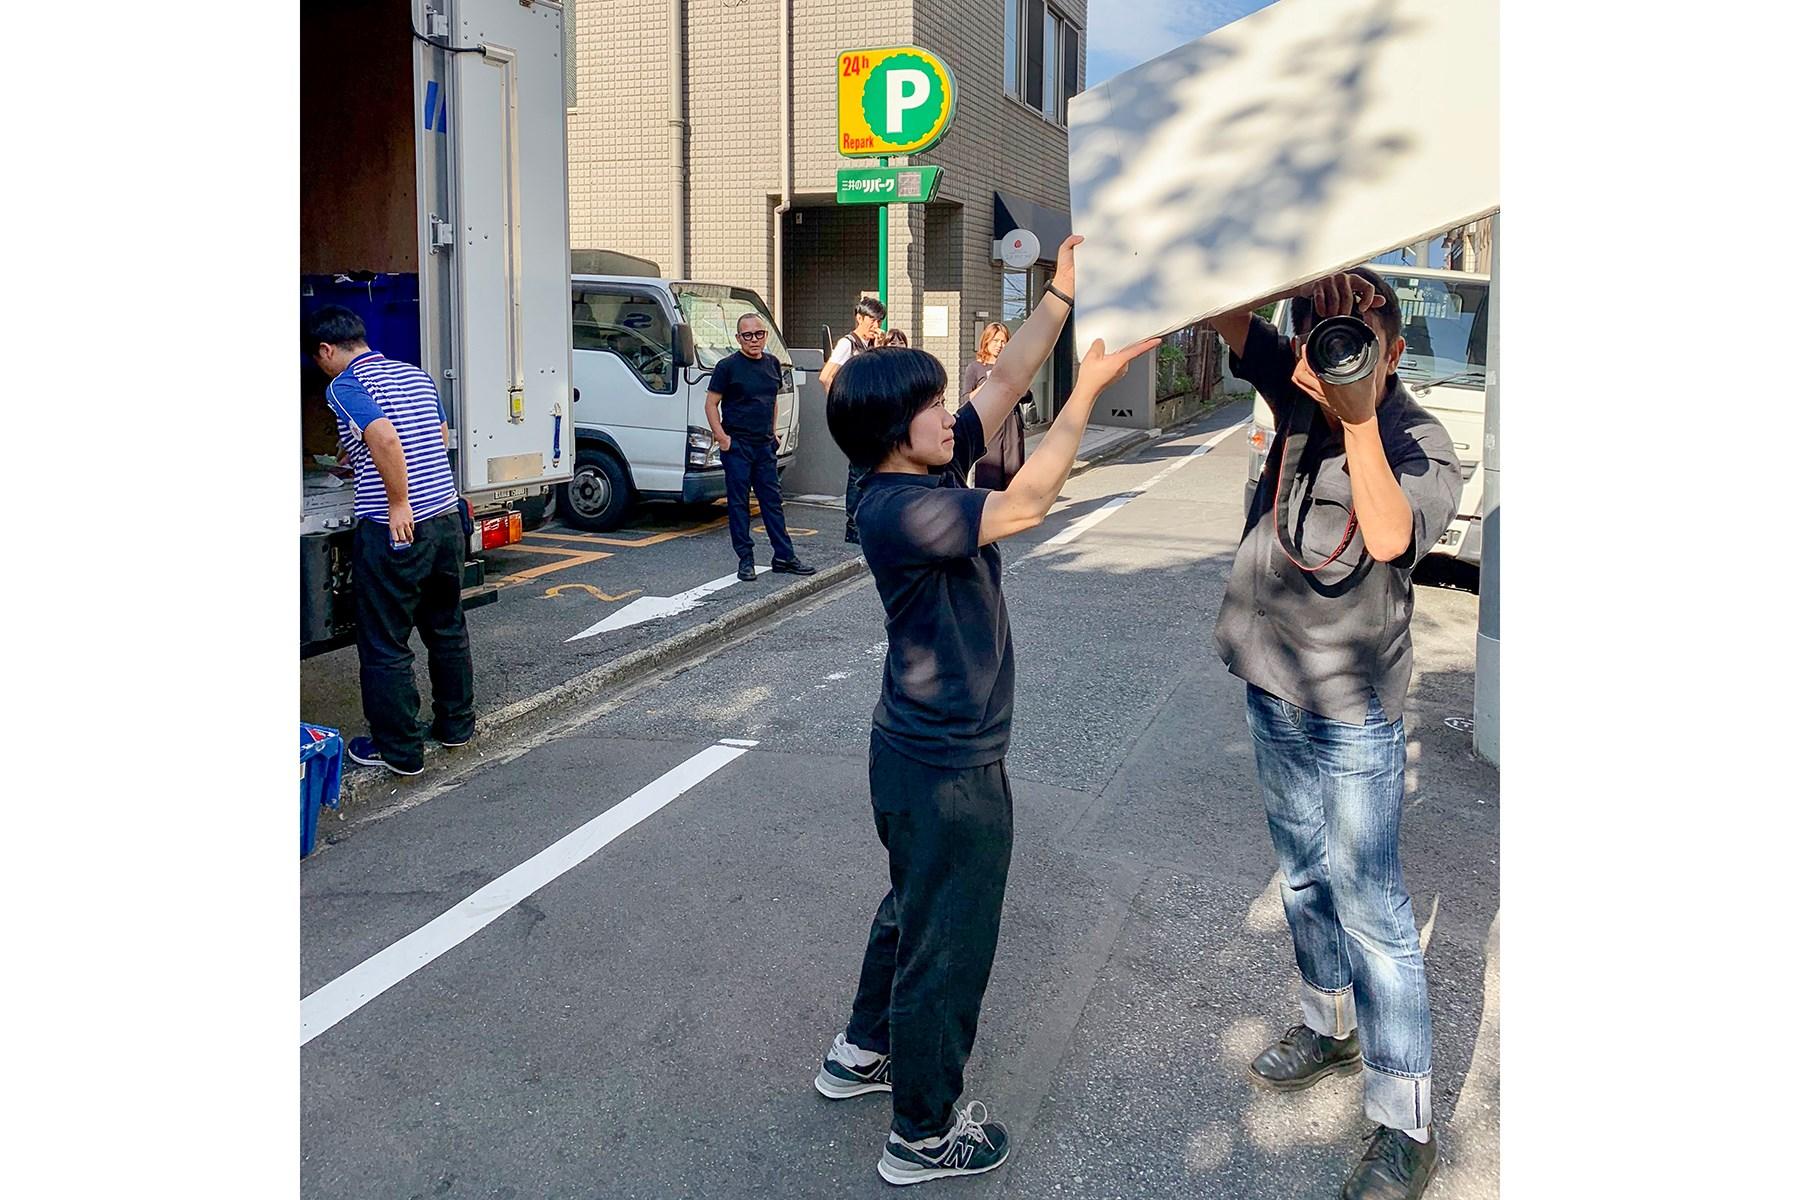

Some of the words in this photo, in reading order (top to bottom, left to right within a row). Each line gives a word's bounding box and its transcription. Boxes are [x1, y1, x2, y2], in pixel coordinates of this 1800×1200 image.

[886, 69, 931, 134] P
[843, 133, 874, 150] Repark
[842, 178, 895, 193] 三井のリパーク
[943, 1141, 975, 1170] N
